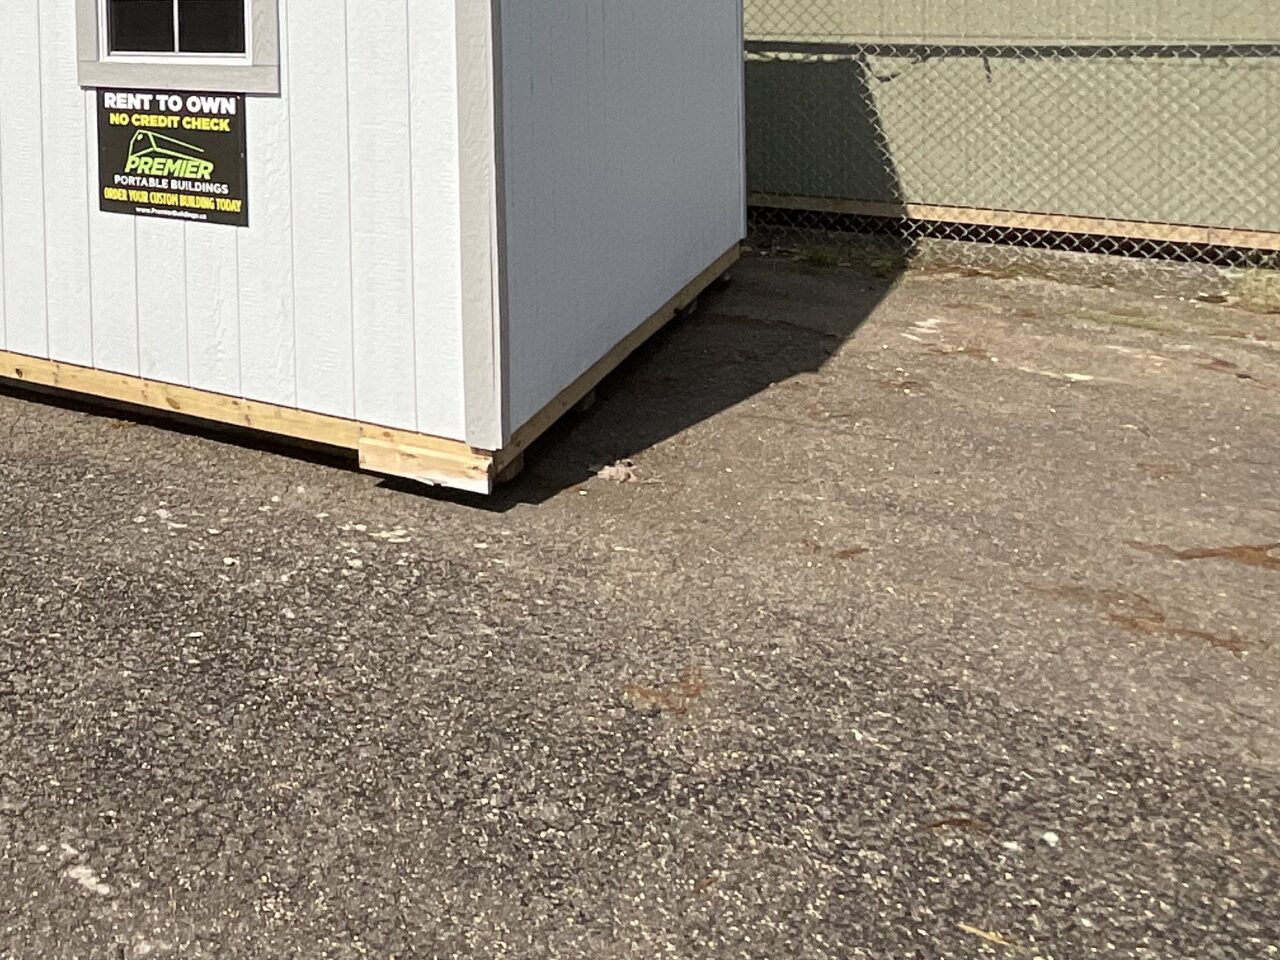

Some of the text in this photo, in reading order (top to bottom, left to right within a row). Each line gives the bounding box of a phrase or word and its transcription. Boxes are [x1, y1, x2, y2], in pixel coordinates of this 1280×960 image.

[104, 92, 236, 115] RENT TO OWN
[109, 113, 231, 132] NO CREDIT CHECK
[124, 156, 214, 180] PREMIER
[114, 174, 229, 195] PORTABLE BUILDINGS
[104, 187, 242, 213] ORDER YOUR CUSTOM BUILDING TODAY
